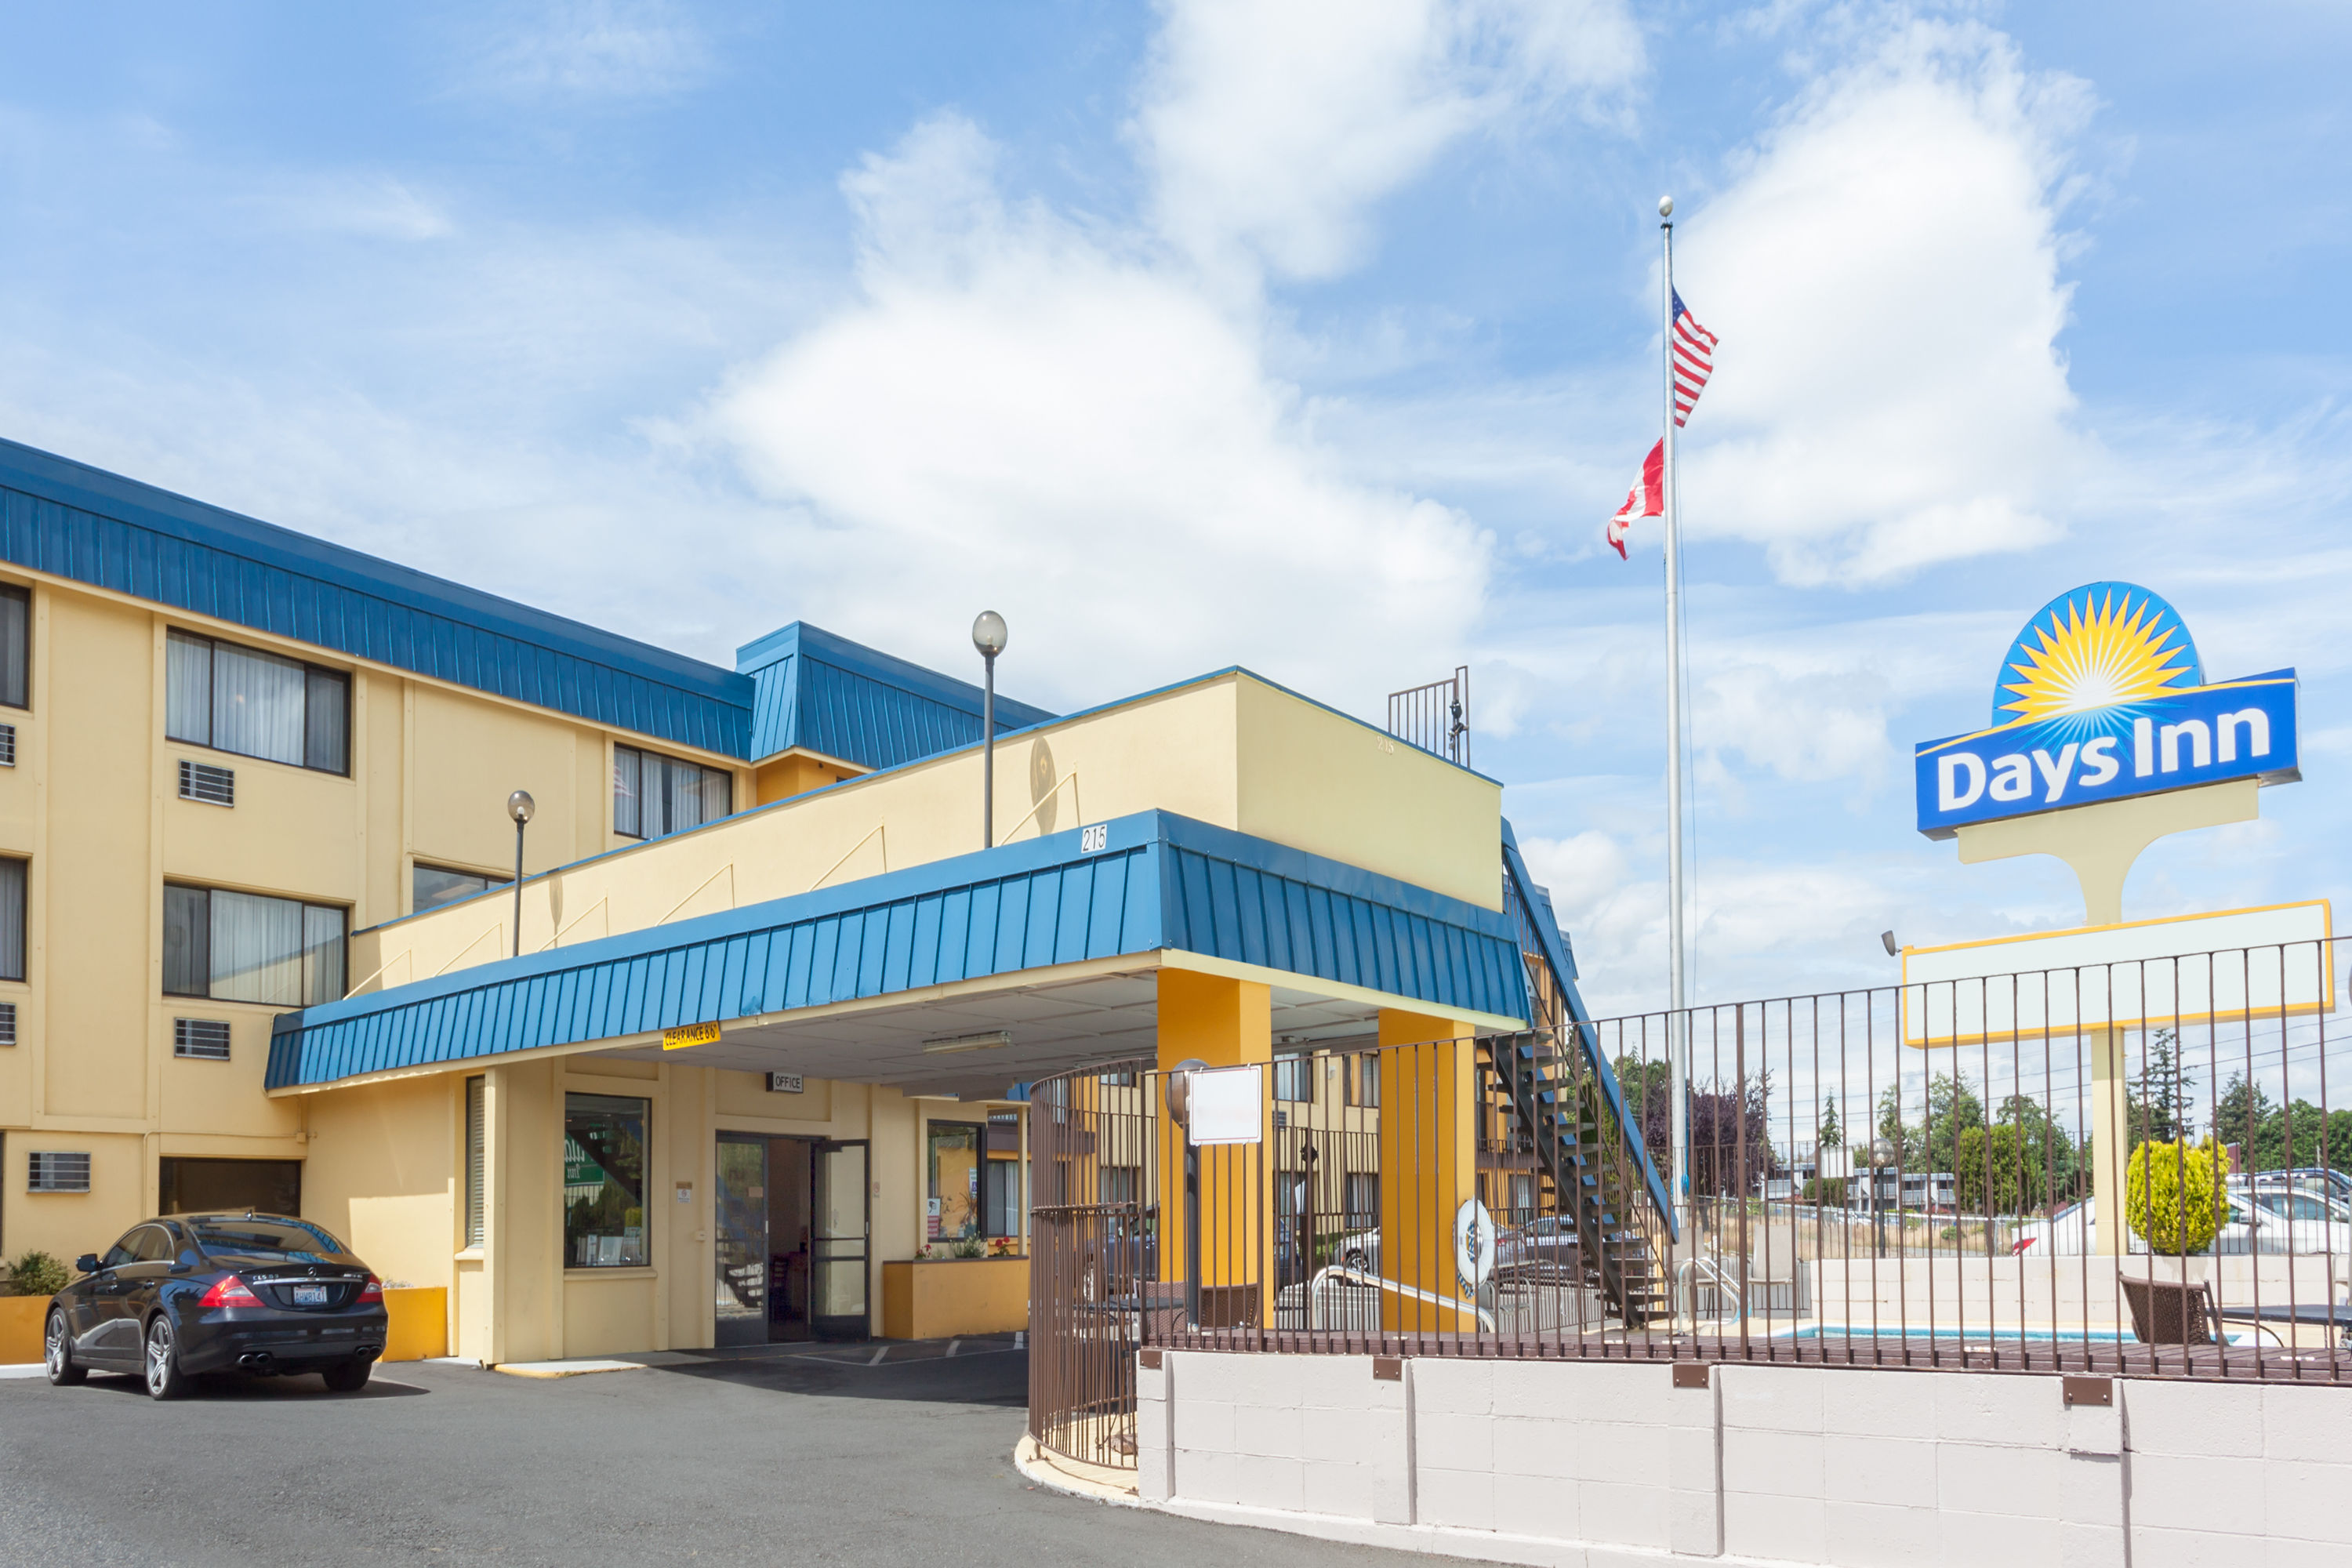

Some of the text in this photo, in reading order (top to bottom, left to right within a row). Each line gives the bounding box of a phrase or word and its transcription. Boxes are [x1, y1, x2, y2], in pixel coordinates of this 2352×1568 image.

[1377, 735, 1394, 753] 215
[1938, 708, 2270, 812] Days Inn
[1083, 826, 1105, 851] 215
[666, 1025, 703, 1046] CLEARANCE
[775, 1076, 800, 1089] OFFICE
